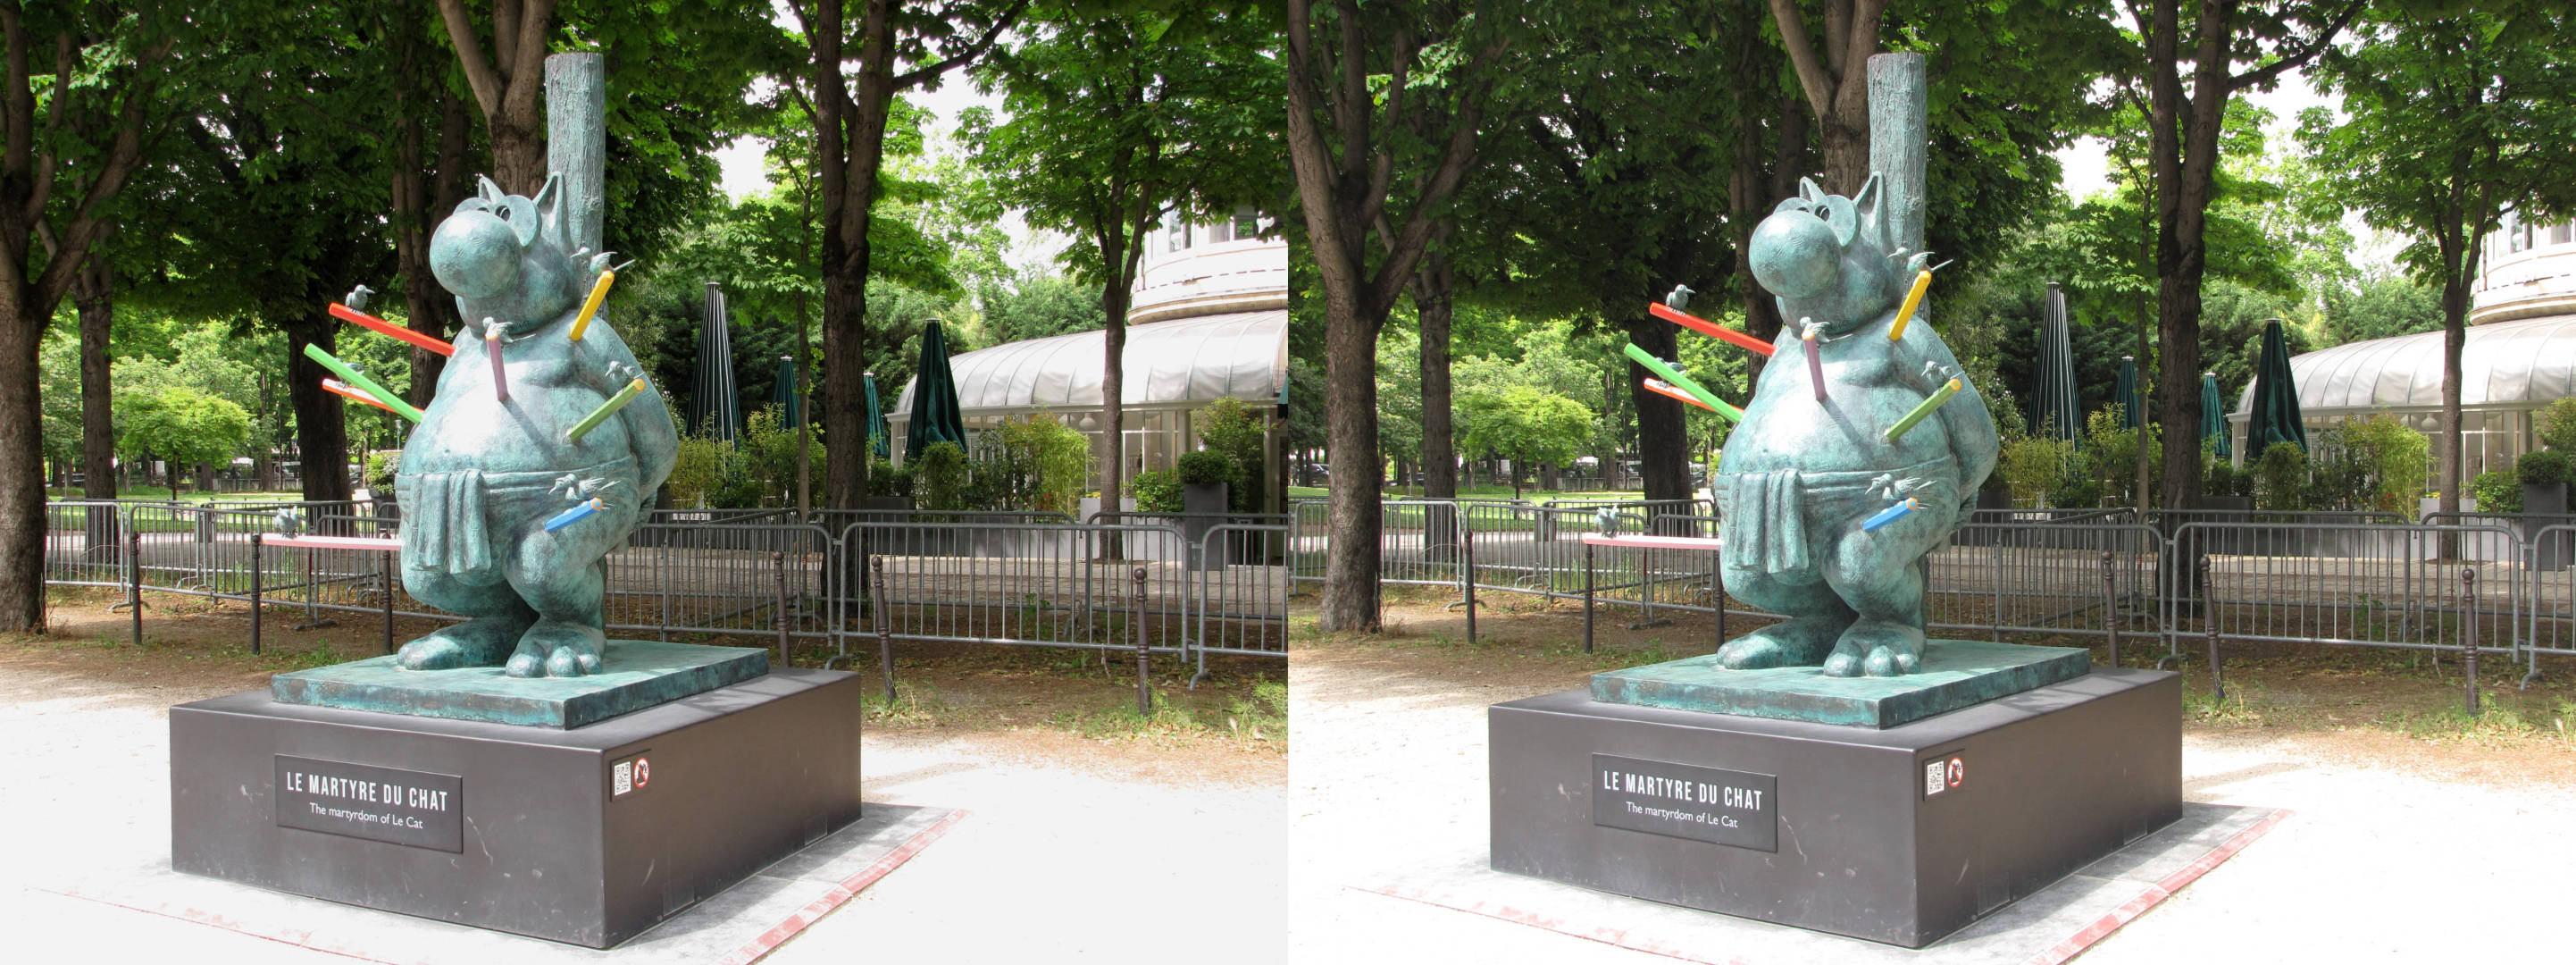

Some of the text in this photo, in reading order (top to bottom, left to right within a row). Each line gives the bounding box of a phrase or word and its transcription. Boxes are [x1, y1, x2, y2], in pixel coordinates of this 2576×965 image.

[287, 771, 447, 811] LE MARTYRE DU CHAT
[1603, 770, 1762, 811] LE MARTYRE DU CHAT
[309, 801, 423, 829] The martyrdom of Le Cat
[1626, 801, 1738, 828] The martyrdom of Le Cat
